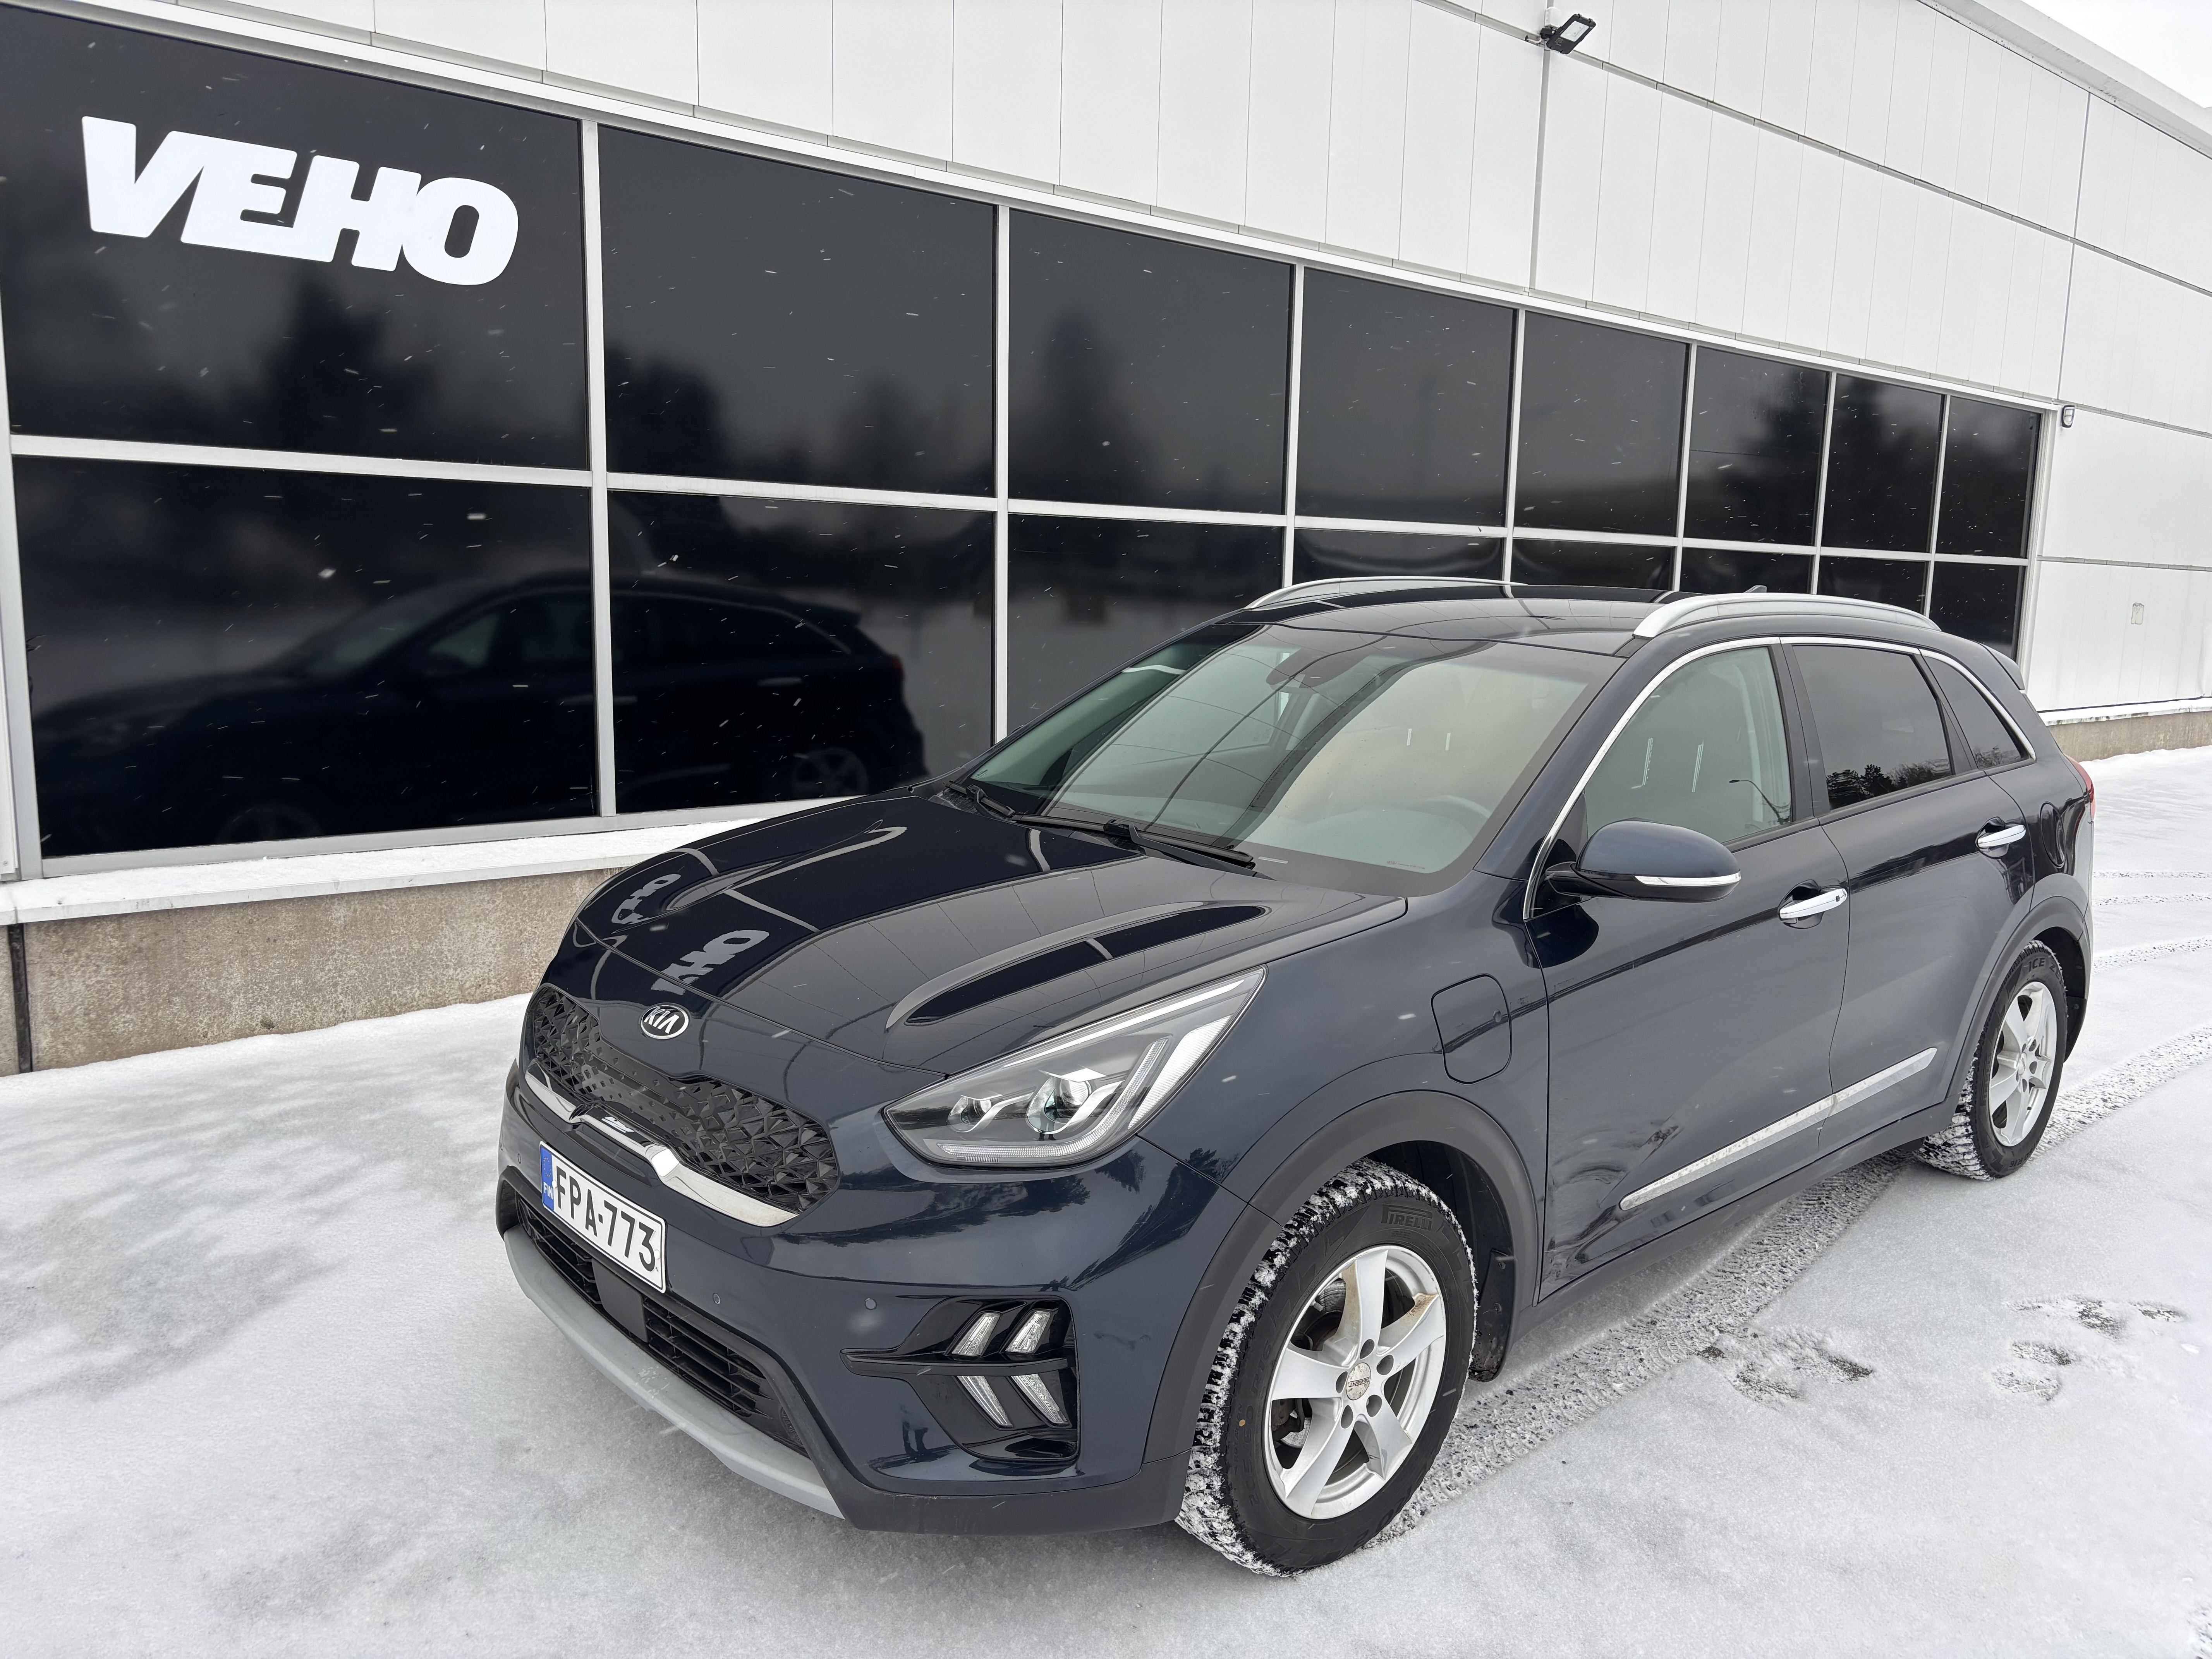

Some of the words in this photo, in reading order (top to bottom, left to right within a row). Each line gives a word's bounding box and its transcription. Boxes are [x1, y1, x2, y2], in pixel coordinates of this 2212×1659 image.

[82, 116, 519, 285] VEHO
[2028, 958, 2045, 972] ICE
[644, 1007, 680, 1034] KIA
[543, 1182, 553, 1200] FIN
[556, 1166, 655, 1272] FPA-773
[1381, 1204, 1433, 1231] PIRELLI
[1348, 1378, 1370, 1387] DEZENT
